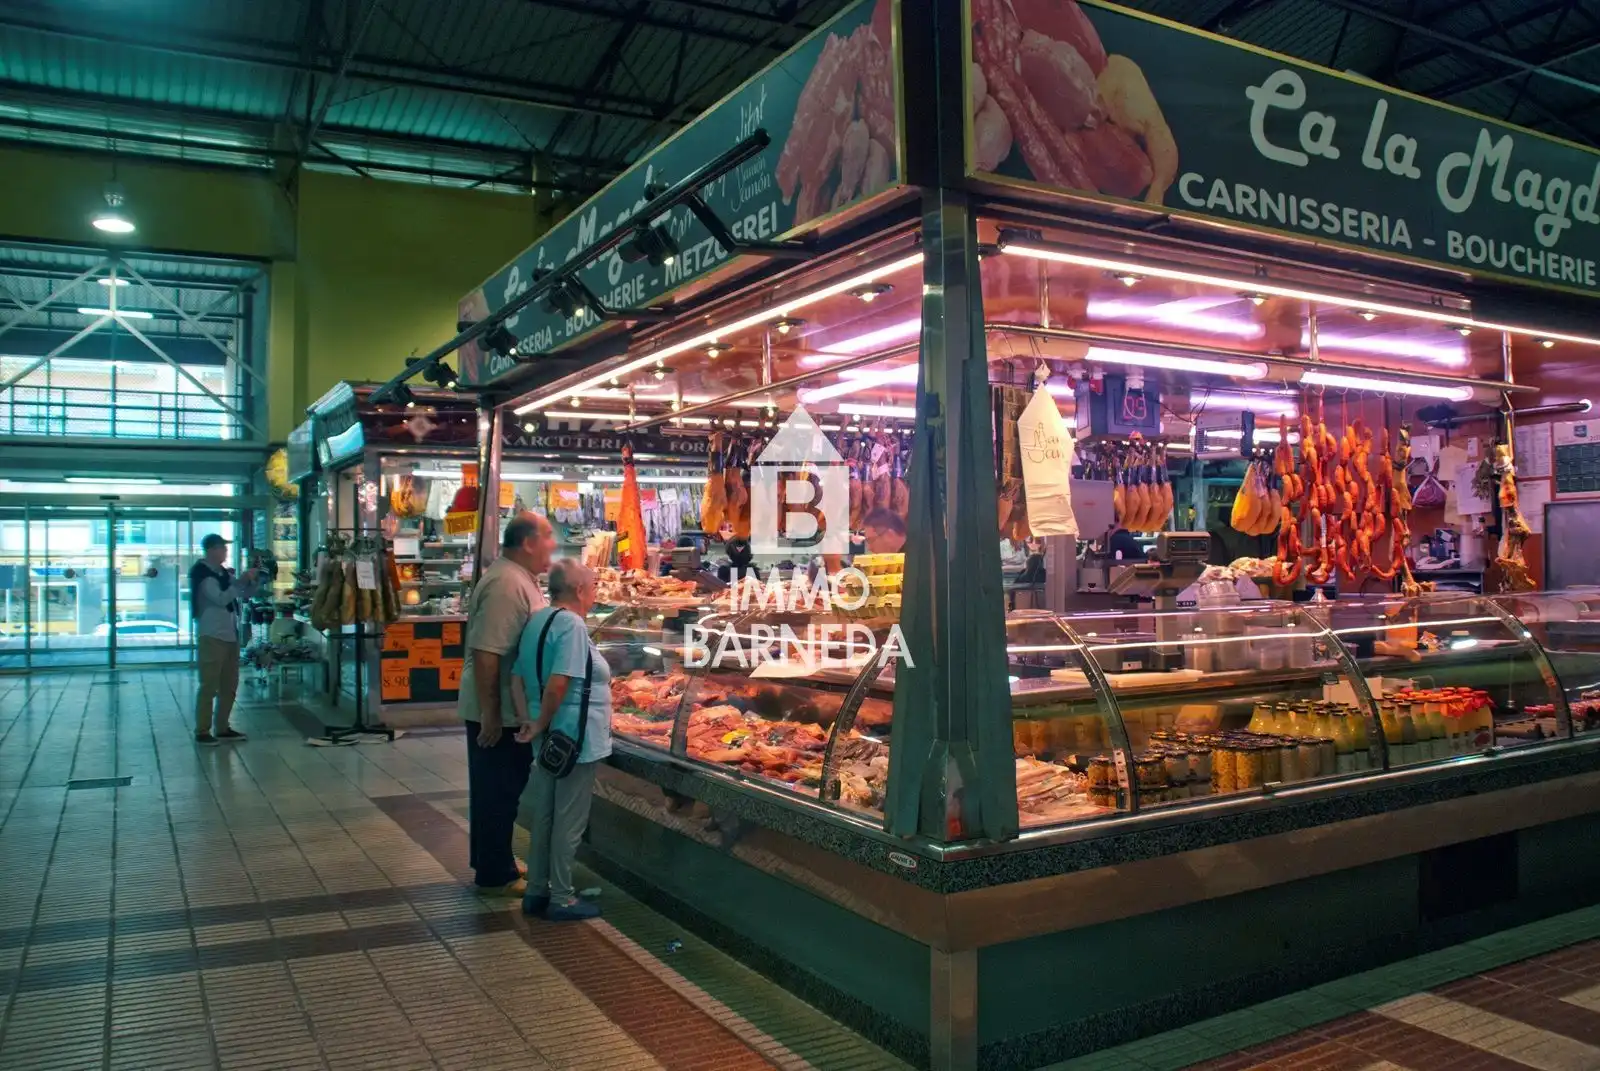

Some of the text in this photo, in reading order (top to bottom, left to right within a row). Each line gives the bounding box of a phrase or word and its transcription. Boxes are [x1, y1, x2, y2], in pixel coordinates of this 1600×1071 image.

[1245, 69, 1340, 167] Ca
[1362, 98, 1421, 179] la
[1179, 172, 1412, 249] CARNISSERIA
[1446, 230, 1597, 286] BOUCHERIE
